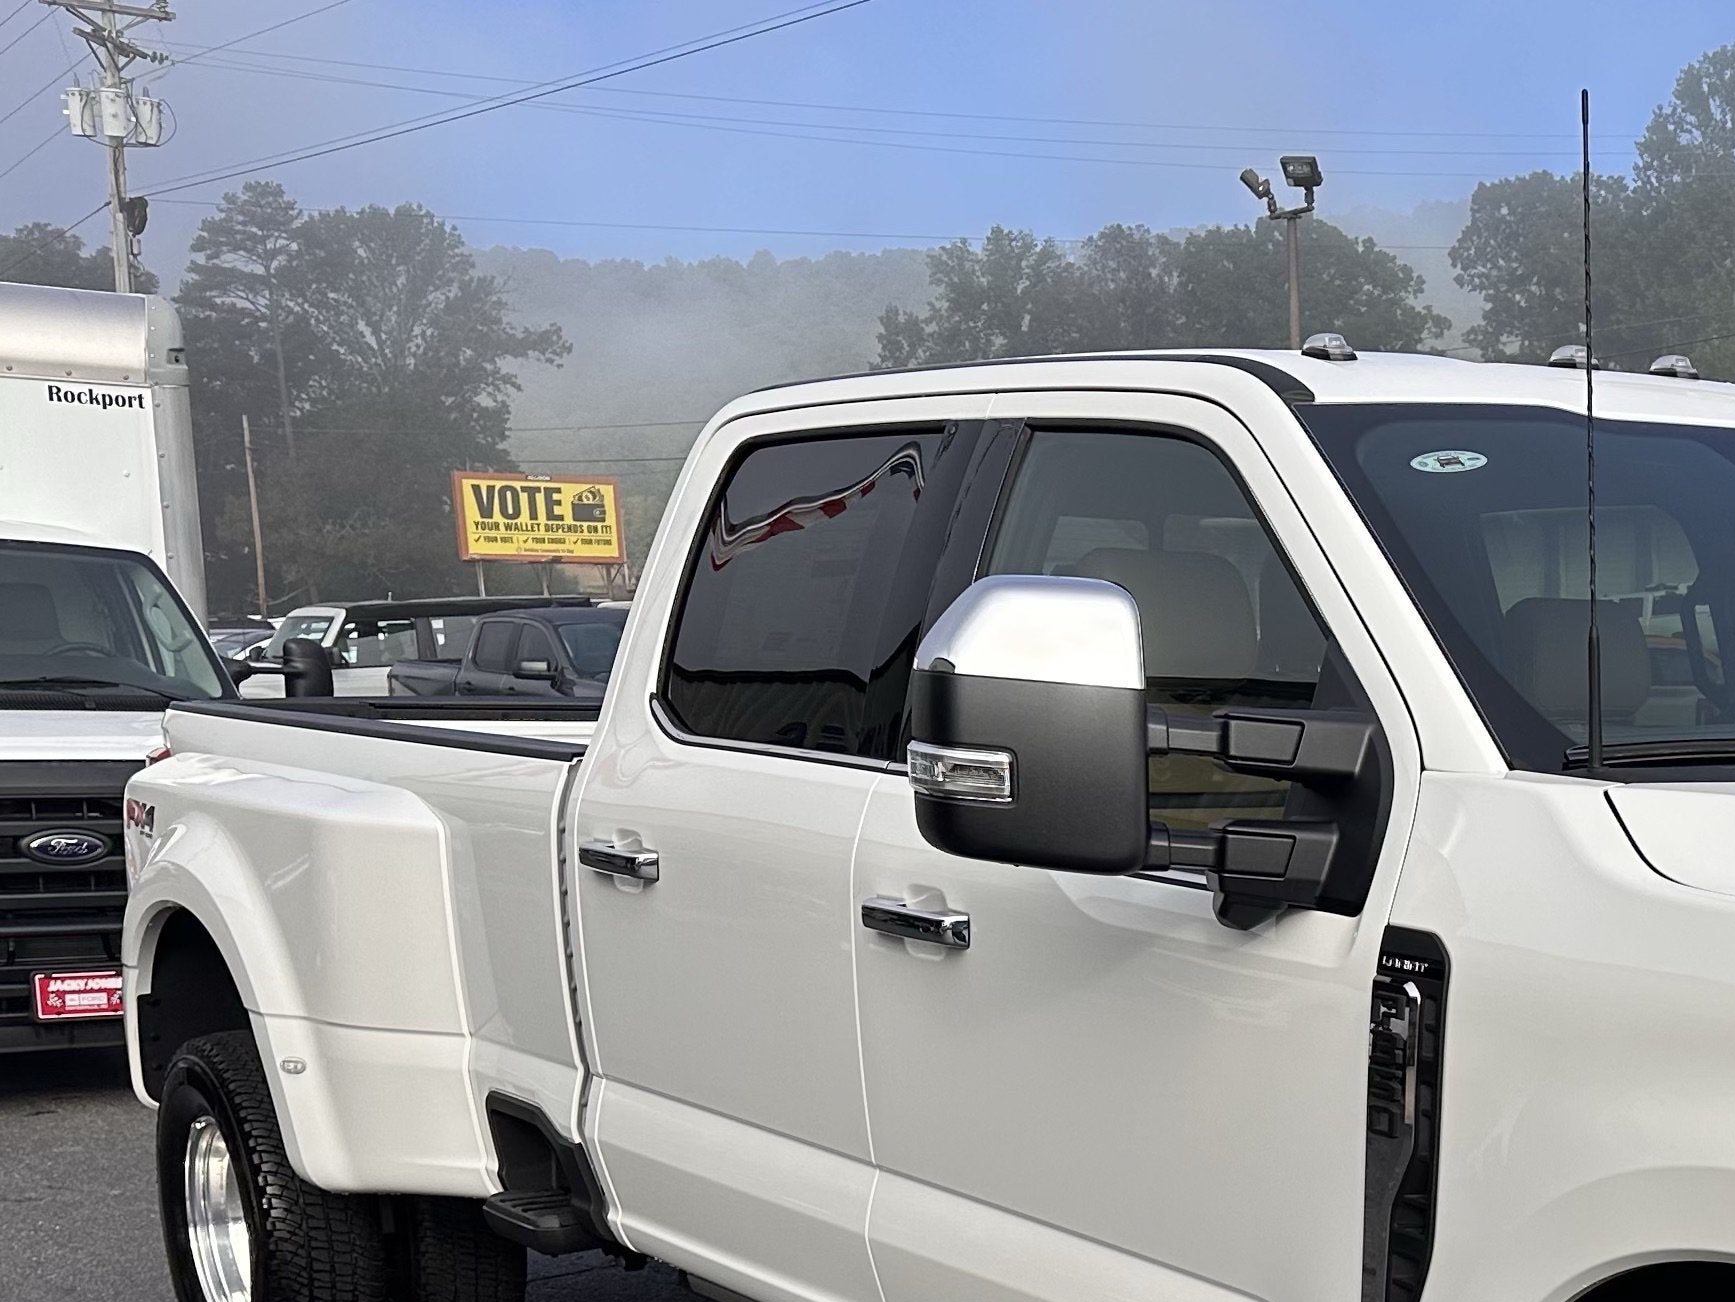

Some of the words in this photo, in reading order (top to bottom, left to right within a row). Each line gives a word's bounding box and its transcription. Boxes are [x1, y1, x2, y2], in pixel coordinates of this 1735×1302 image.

[47, 384, 146, 410] Rockport
[471, 483, 565, 522] VOTE
[473, 520, 501, 532] YOUR
[504, 521, 541, 533] WALLET
[544, 523, 584, 534] DEPENDS
[587, 524, 598, 535] ON
[601, 525, 612, 535] IT!
[48, 838, 88, 854] Ford
